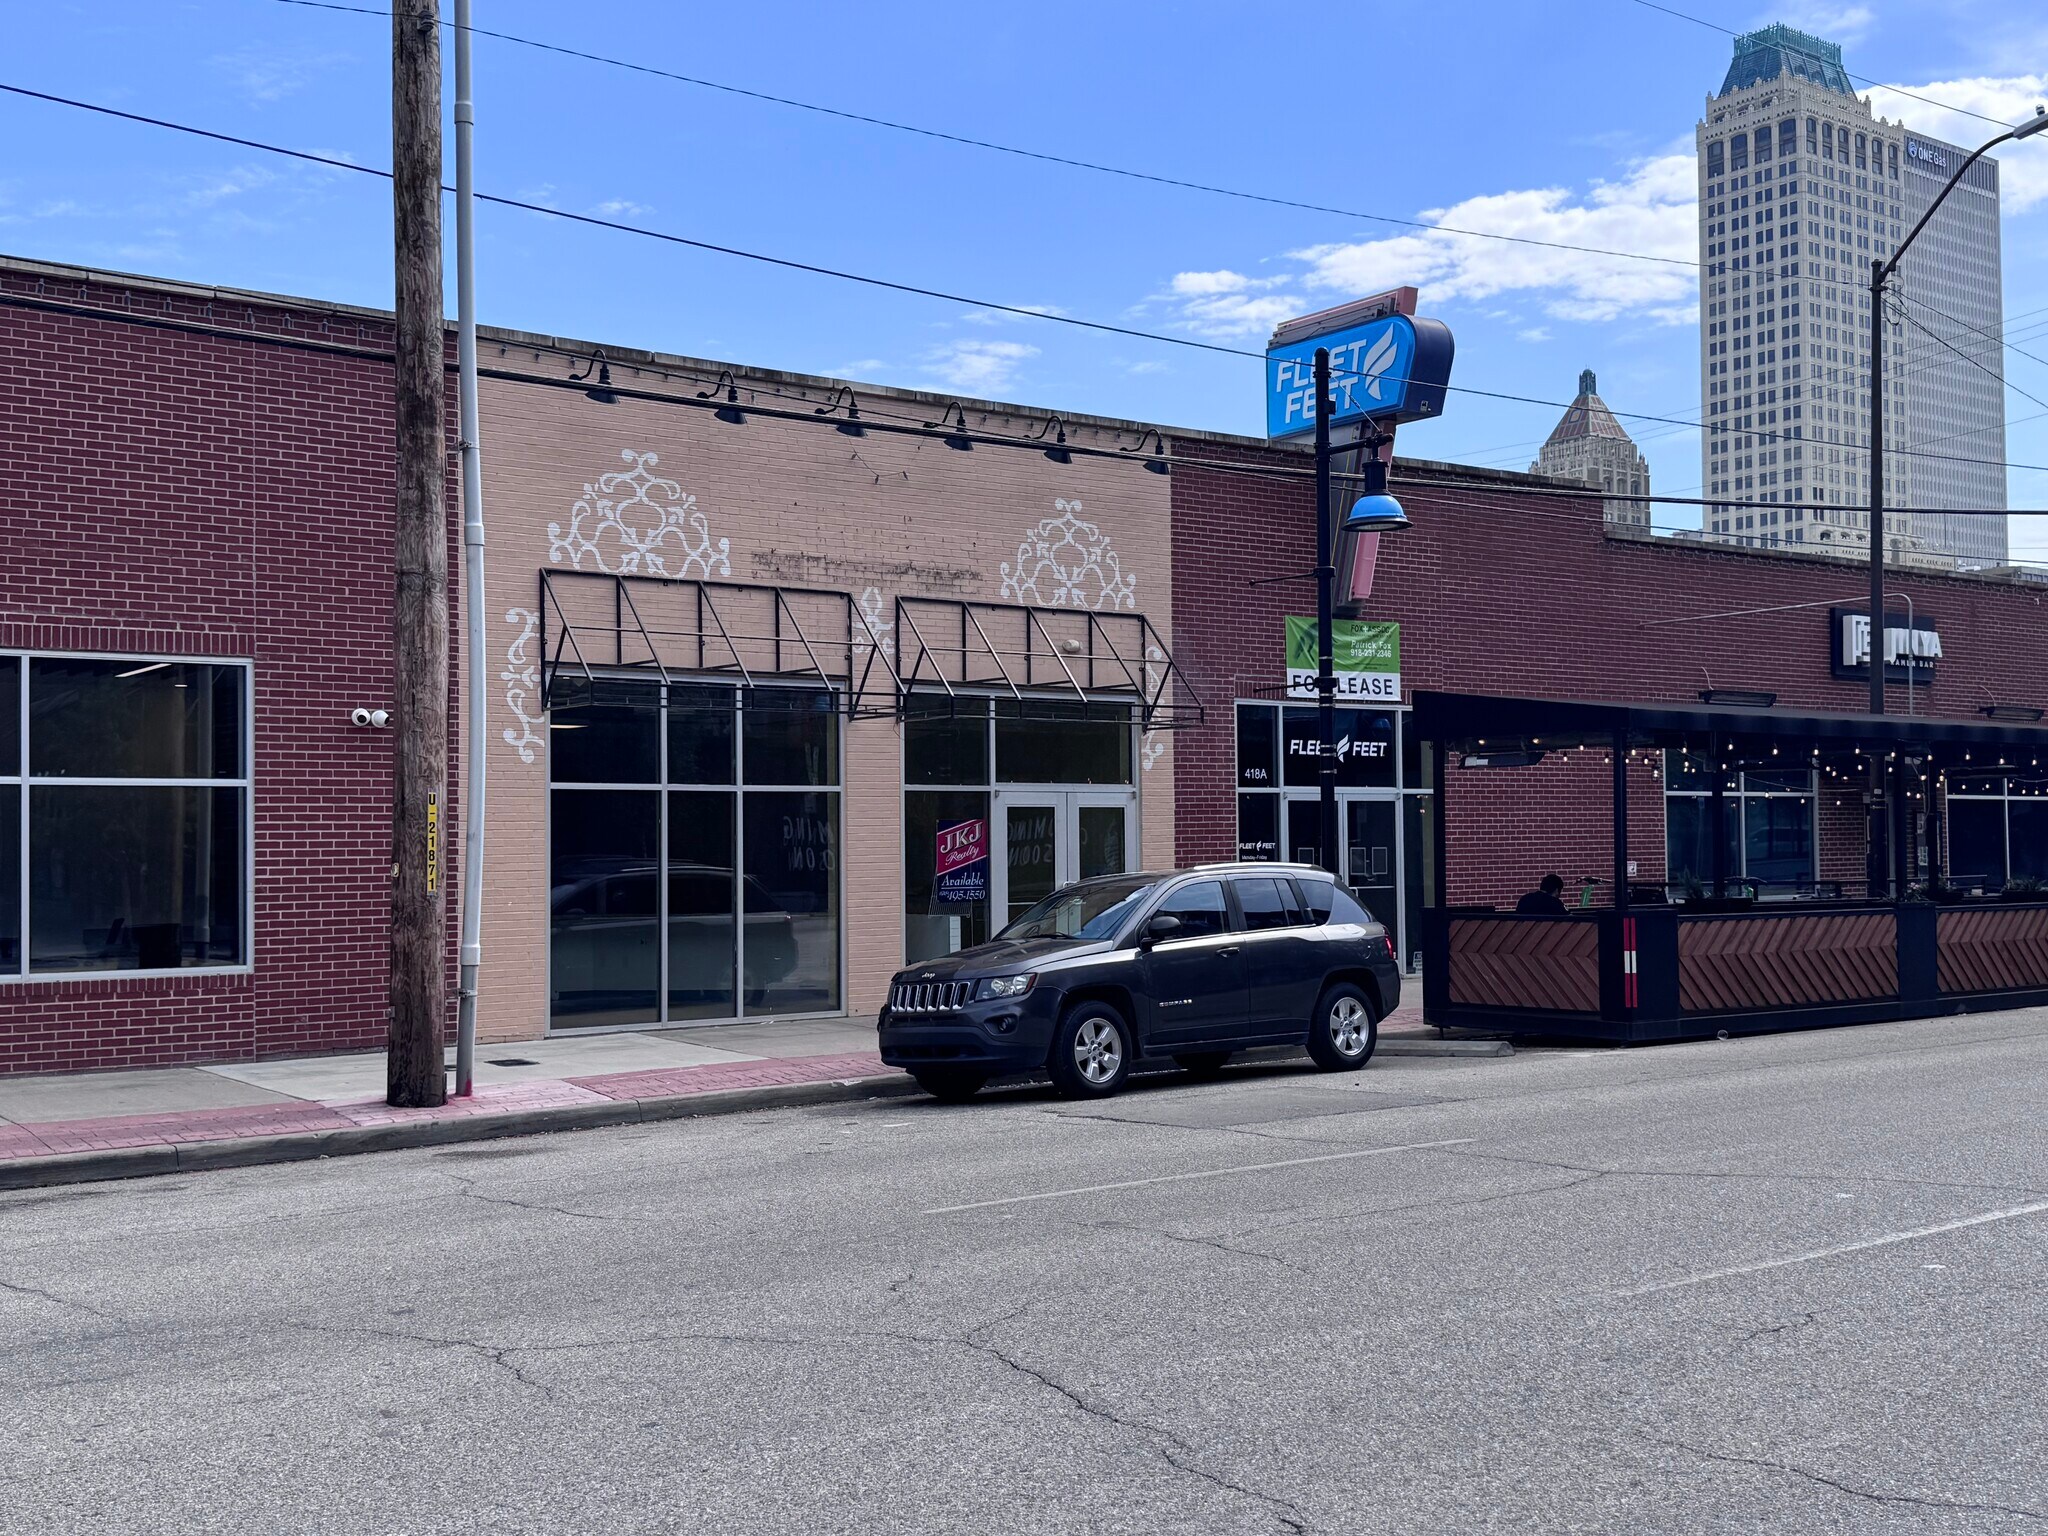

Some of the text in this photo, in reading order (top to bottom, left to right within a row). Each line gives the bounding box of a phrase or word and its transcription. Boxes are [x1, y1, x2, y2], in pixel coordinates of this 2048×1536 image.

[1918, 148, 1933, 163] ONE
[1351, 640, 1392, 650] Patrick Fox
[1919, 660, 1934, 668] BAR
[1293, 675, 1393, 695] FO LEASE
[1289, 739, 1388, 757] FLEE FEET
[1244, 768, 1267, 780] 418A
[428, 793, 436, 890] U-21871
[940, 821, 983, 854] JKJ
[1239, 842, 1276, 850] FLEET FEET
[945, 844, 980, 866] Realty
[941, 872, 984, 887] Available
